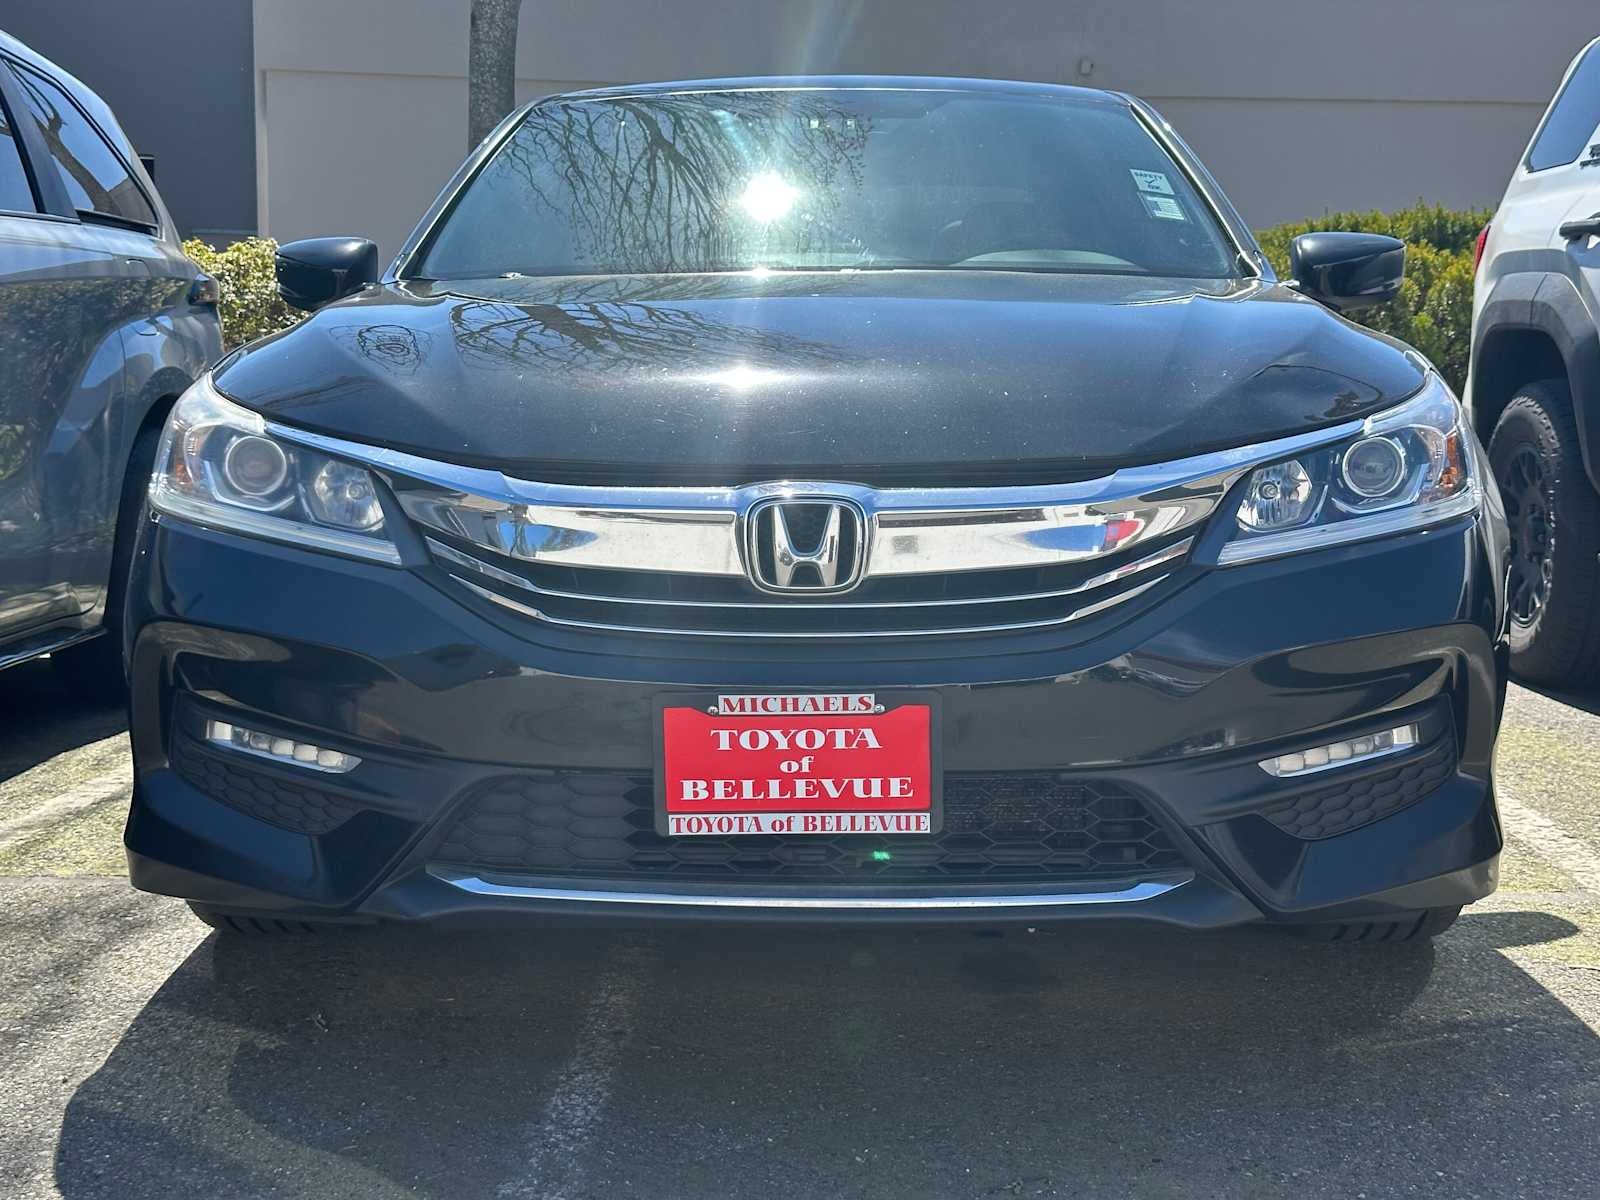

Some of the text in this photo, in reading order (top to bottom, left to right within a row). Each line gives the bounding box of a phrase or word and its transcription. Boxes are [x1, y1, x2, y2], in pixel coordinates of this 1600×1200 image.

[722, 696, 874, 713] MICHAELS
[710, 728, 883, 751] TOYOTA
[779, 755, 814, 773] of
[680, 777, 914, 801] BELLEVUE
[670, 815, 929, 834] TOYOTA of BELLEVUE
